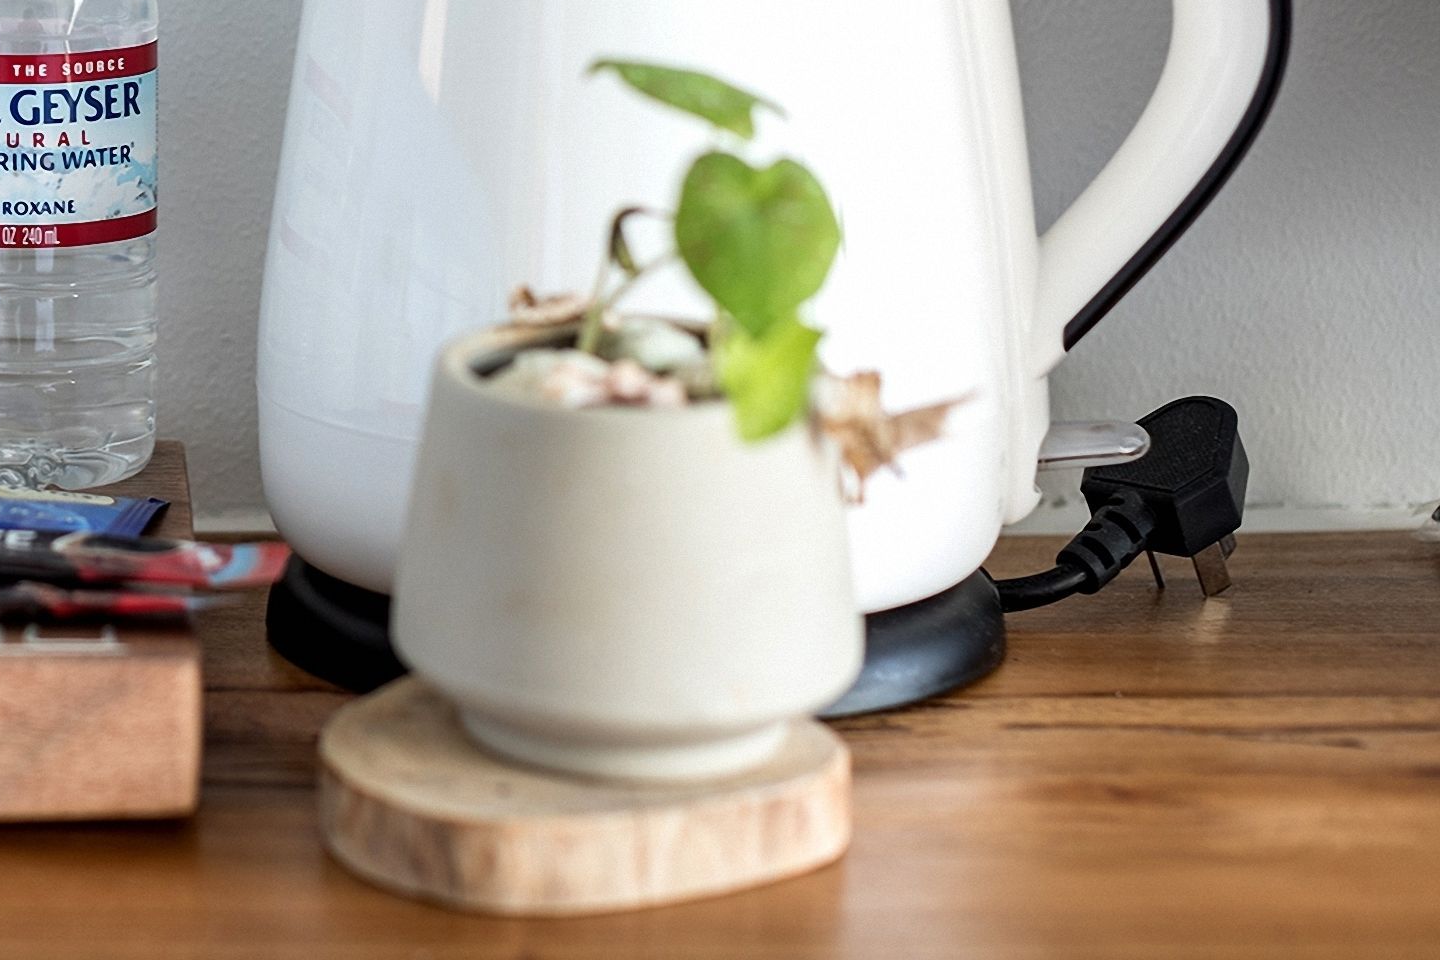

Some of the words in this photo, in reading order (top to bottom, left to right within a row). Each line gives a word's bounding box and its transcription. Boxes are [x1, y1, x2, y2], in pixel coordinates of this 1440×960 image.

[13, 63, 48, 77] THE
[61, 57, 126, 76] SOURCE
[9, 81, 141, 126] GEYSER
[61, 144, 131, 169] WATER
[2, 199, 77, 216] ROXANE
[2, 227, 17, 245] OZ
[22, 226, 42, 245] 240
